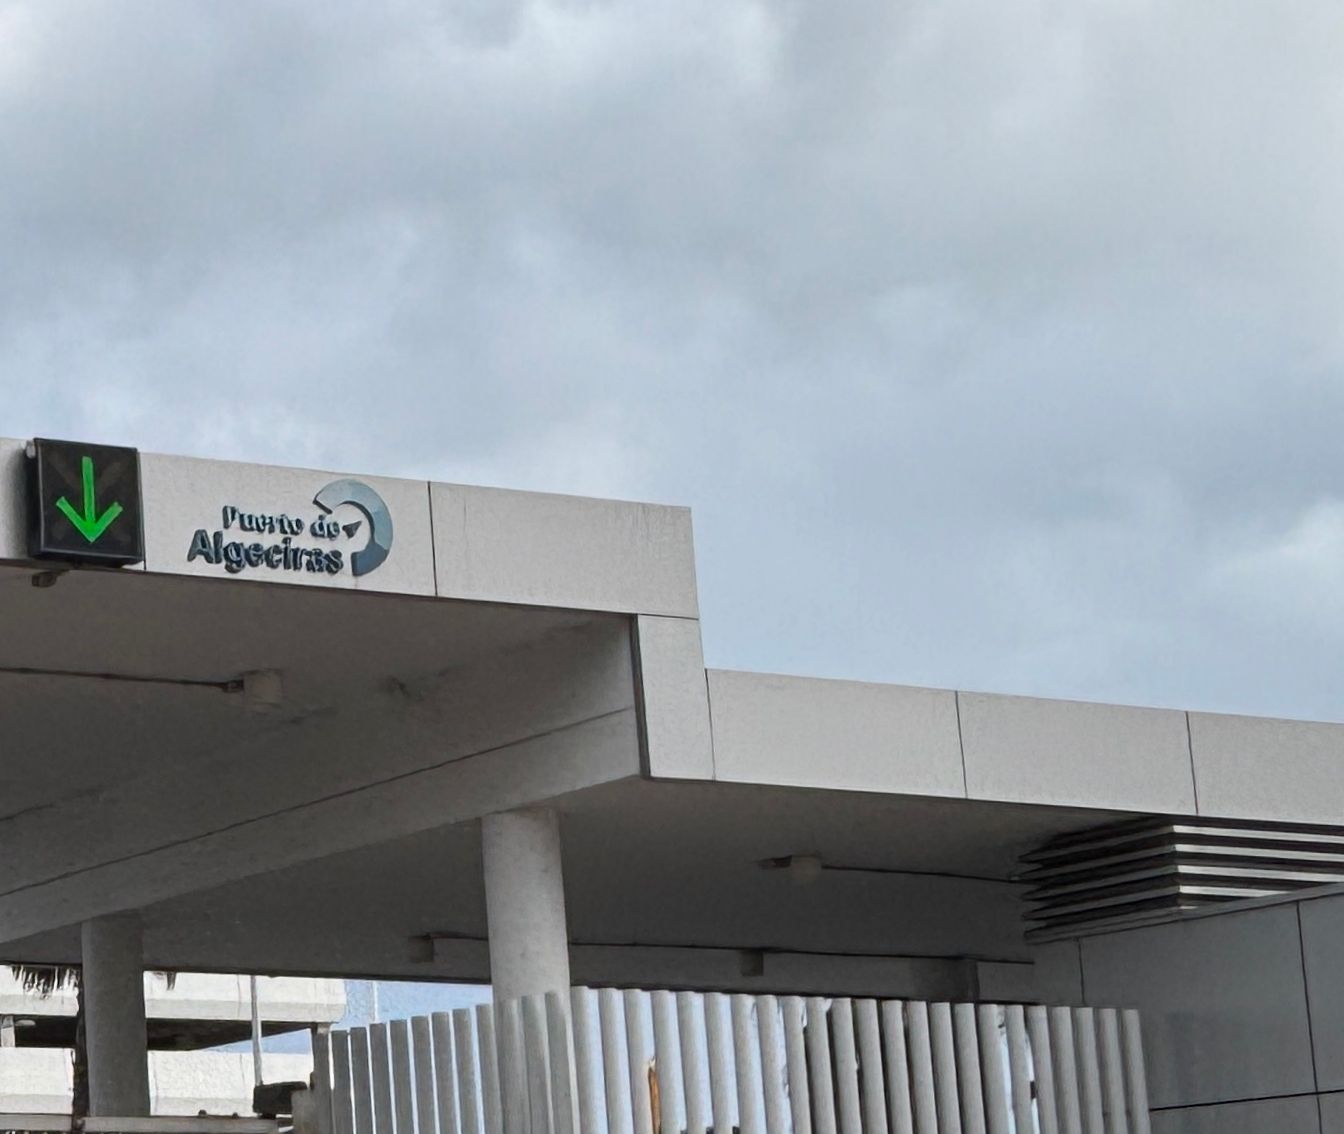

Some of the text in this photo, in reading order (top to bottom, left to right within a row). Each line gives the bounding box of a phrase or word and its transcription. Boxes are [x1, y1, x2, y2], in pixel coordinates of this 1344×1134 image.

[223, 506, 340, 539] Puerto de
[187, 528, 344, 575] Algeciras
